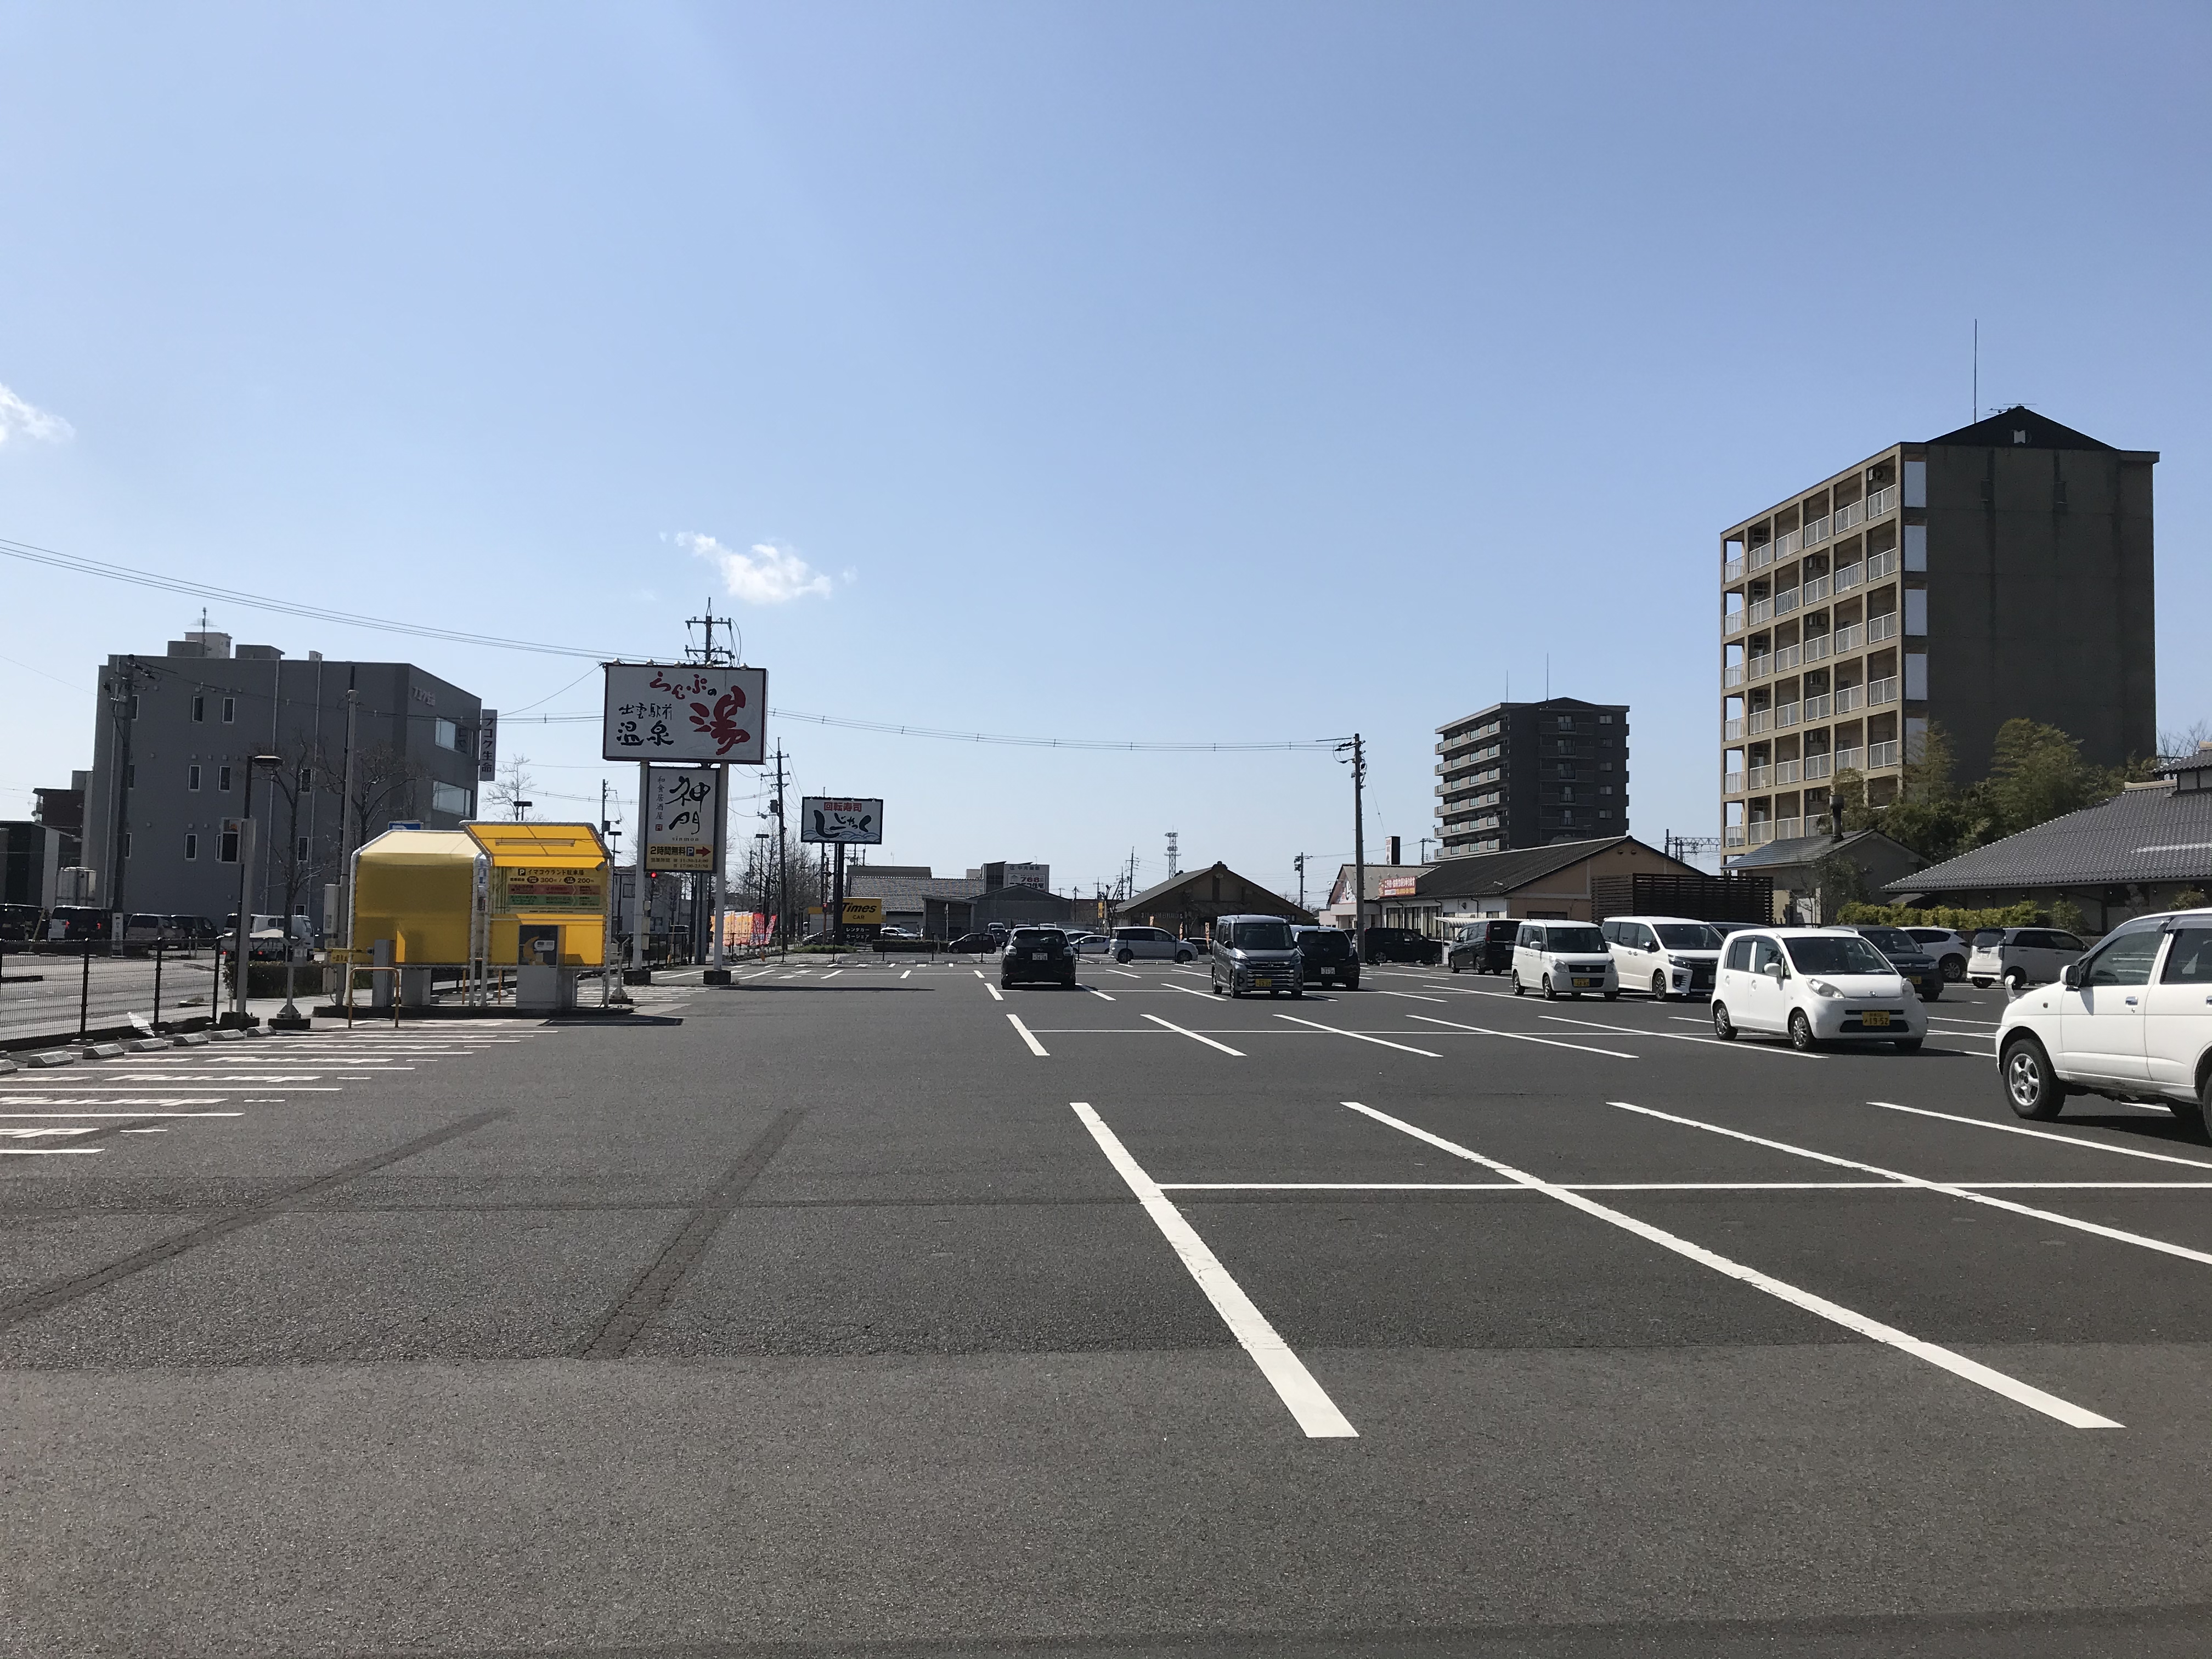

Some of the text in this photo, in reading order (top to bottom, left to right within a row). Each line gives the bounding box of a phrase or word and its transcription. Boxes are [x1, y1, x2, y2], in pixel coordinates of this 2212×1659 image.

[618, 702, 672, 720] 出雲駅前
[616, 720, 674, 746] 温泉
[482, 718, 493, 772] フコク生命
[656, 776, 665, 820] 和食居酒屋
[823, 802, 862, 812] 回転寿司
[650, 847, 686, 855] 2時間無料
[843, 902, 877, 913] Times
